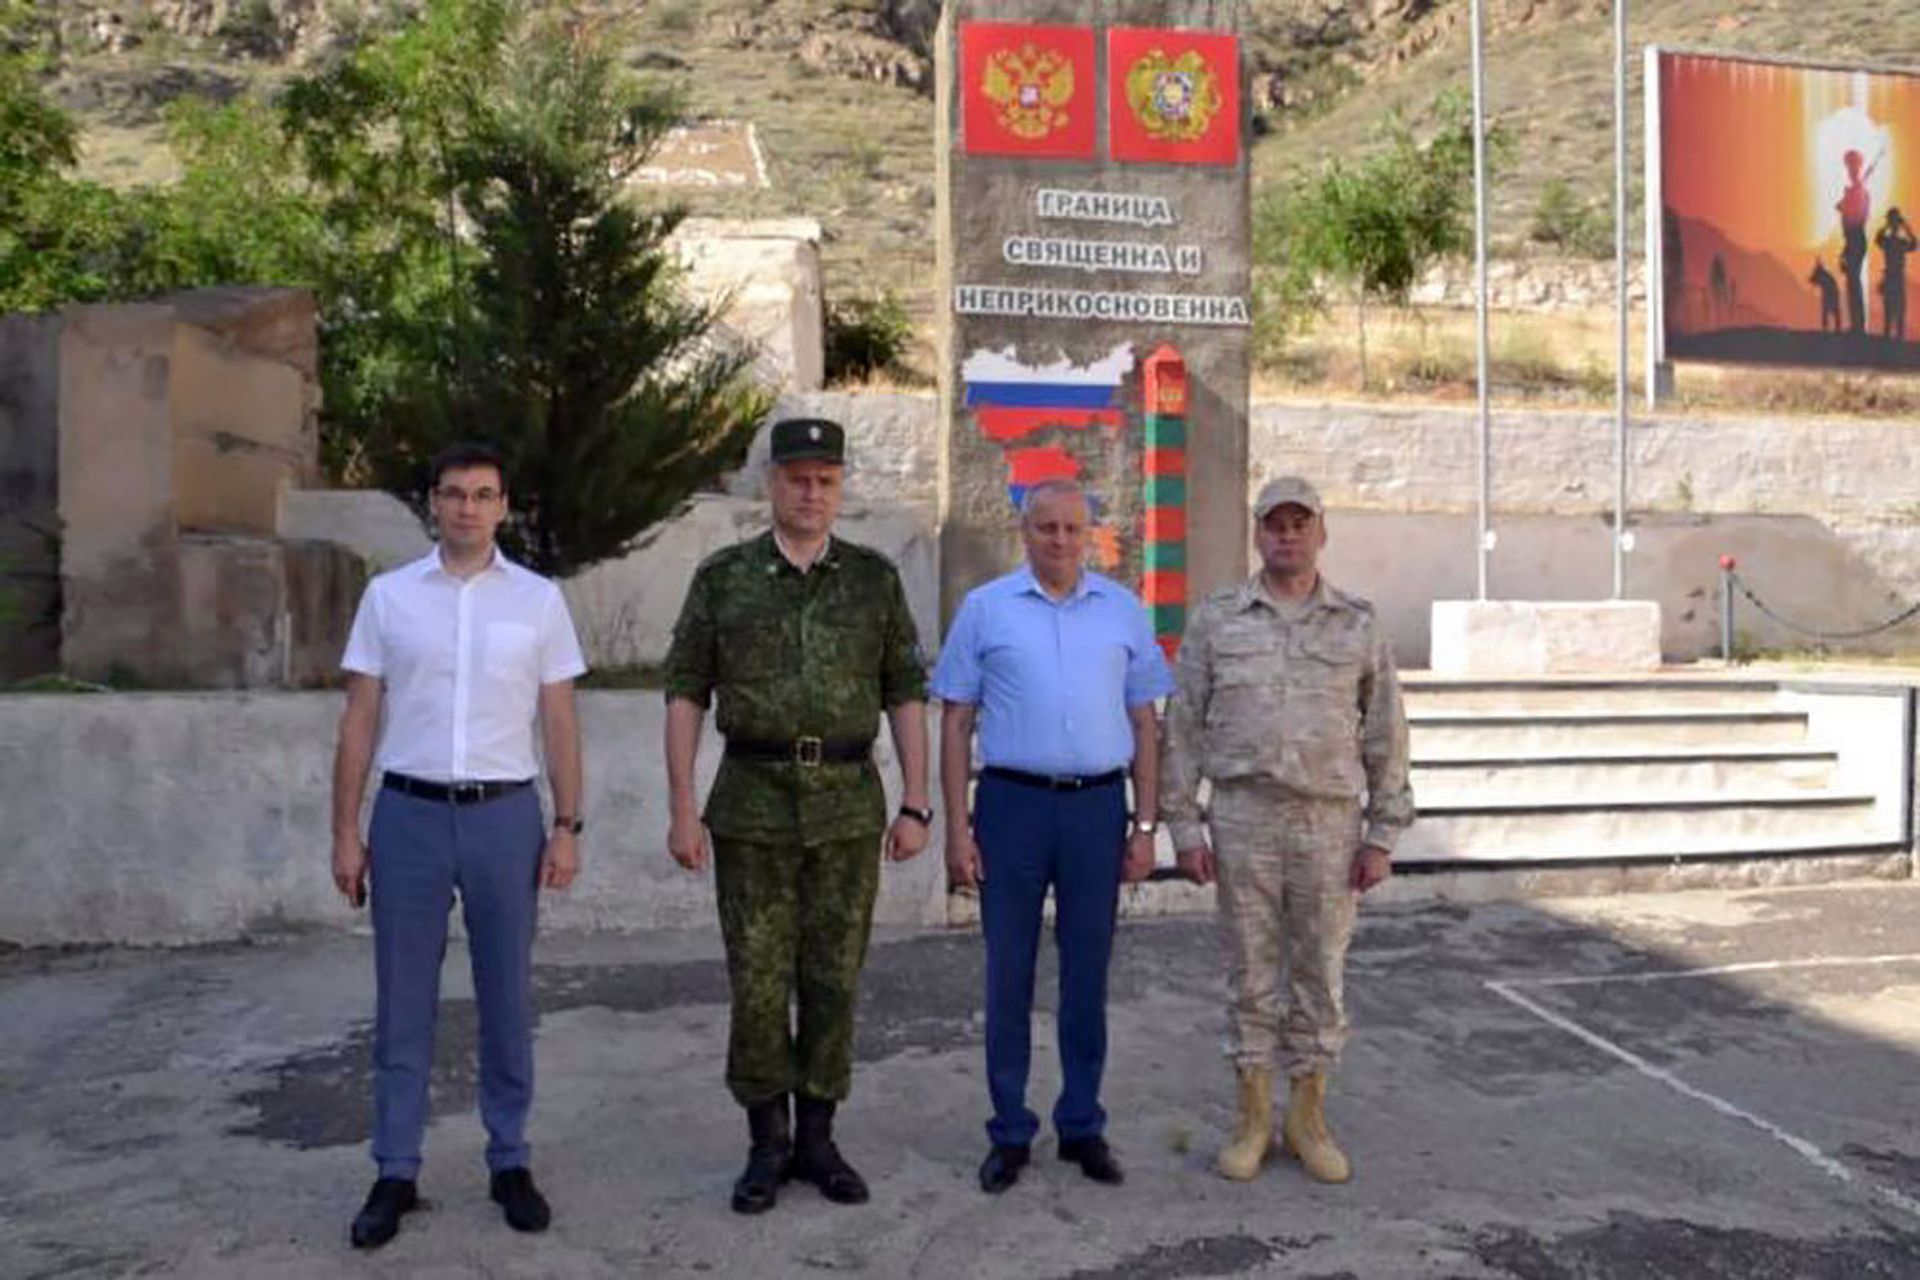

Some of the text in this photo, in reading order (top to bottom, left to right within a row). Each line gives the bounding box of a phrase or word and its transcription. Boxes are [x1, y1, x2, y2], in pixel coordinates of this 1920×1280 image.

[1039, 190, 1172, 225] ГРАНИЦА
[1004, 237, 1199, 272] СВЯЩЕННА И
[957, 286, 1248, 323] НЕПРИКОСНОВЕННА
